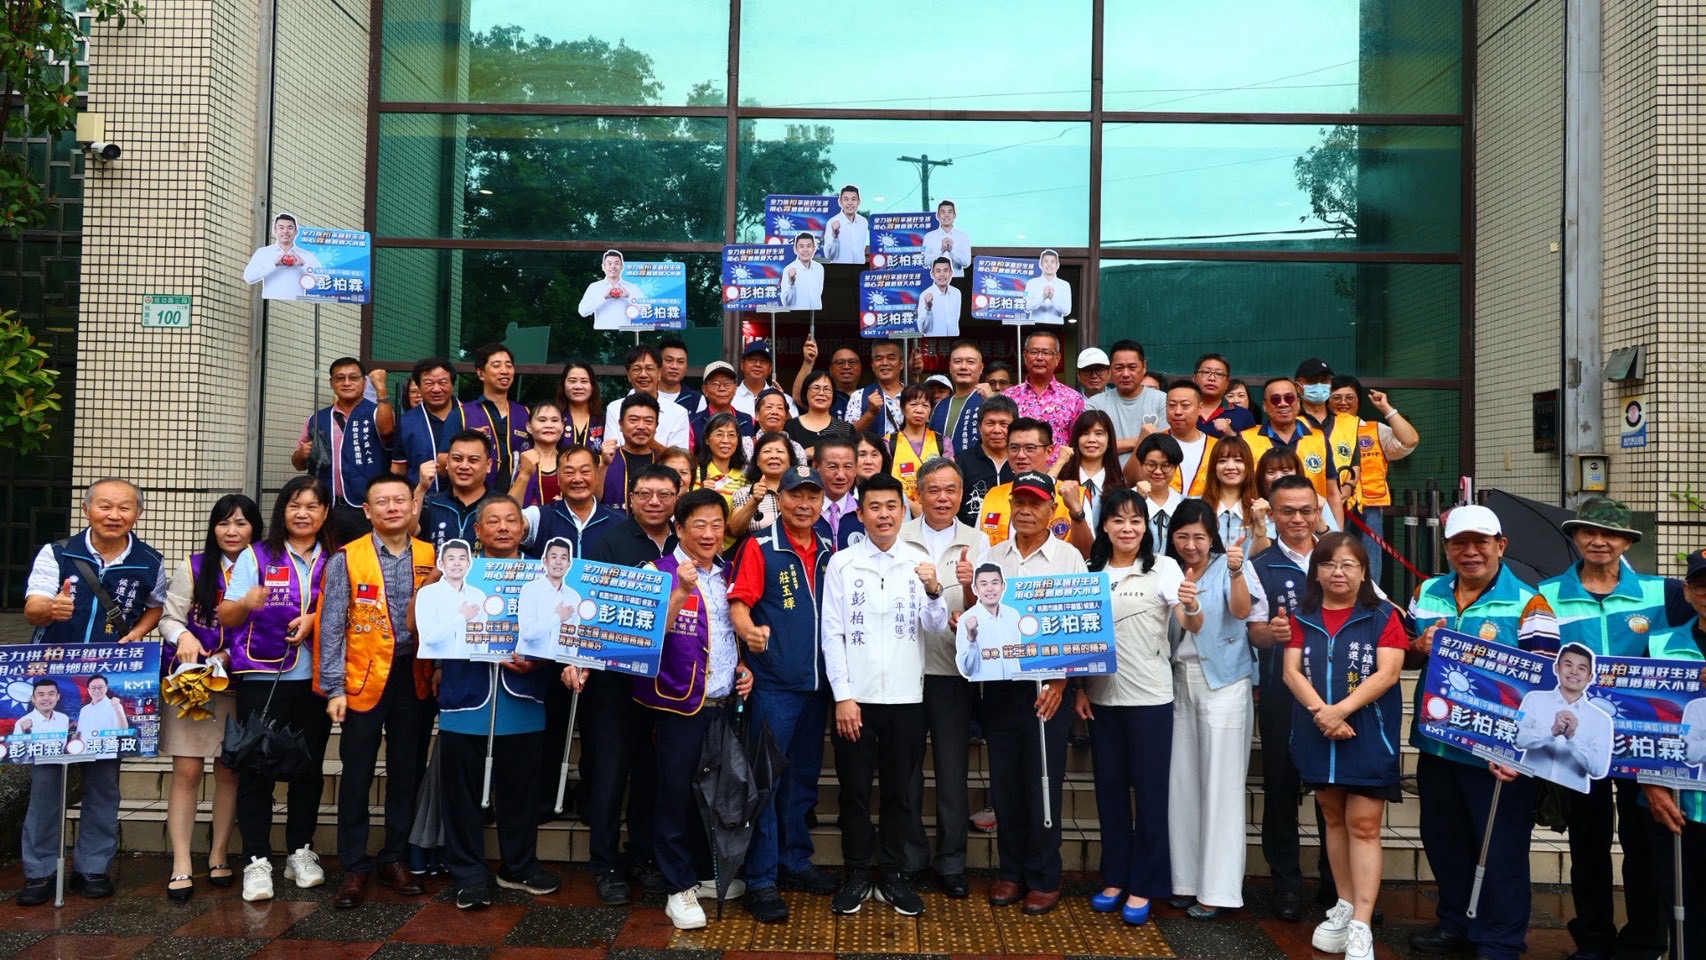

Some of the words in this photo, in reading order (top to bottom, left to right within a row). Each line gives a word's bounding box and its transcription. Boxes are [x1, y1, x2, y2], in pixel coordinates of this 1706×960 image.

[886, 253, 924, 268] 彭柏霖
[317, 274, 364, 292] 彭柏霖
[740, 286, 778, 299] 彭柏霖
[989, 296, 1026, 310] 彭柏霖
[157, 309, 182, 325] 100
[640, 305, 681, 319] 彭柏霖
[876, 311, 915, 325] 彭柏霖
[583, 564, 663, 583] 全力拼柏平鎮好生活
[581, 574, 662, 594] 用心霖聽鄉親大小事
[779, 571, 796, 610] 莊玉輝
[1015, 577, 1099, 591] 全力拼柏平鎮好生活
[1014, 588, 1100, 601] 用心霖聽鄉親大小事
[598, 604, 655, 630] 彭柏霖
[849, 591, 866, 646] 彭柏霖
[1041, 613, 1101, 635] 彭柏霖
[0, 647, 144, 662] 全力拼柏平鎮好生活
[1441, 636, 1544, 673] 全力拼柏平鎮好生活
[0, 661, 144, 676] 用心霖聽鄉親大小事
[1438, 647, 1542, 684] 用心霖聽鄉親大小事
[124, 680, 152, 690] KMT
[1425, 724, 1446, 737] KMT
[1450, 705, 1518, 745] 彭柏霖
[9, 741, 63, 758] 彭柏霖
[87, 738, 137, 754] 張善政
